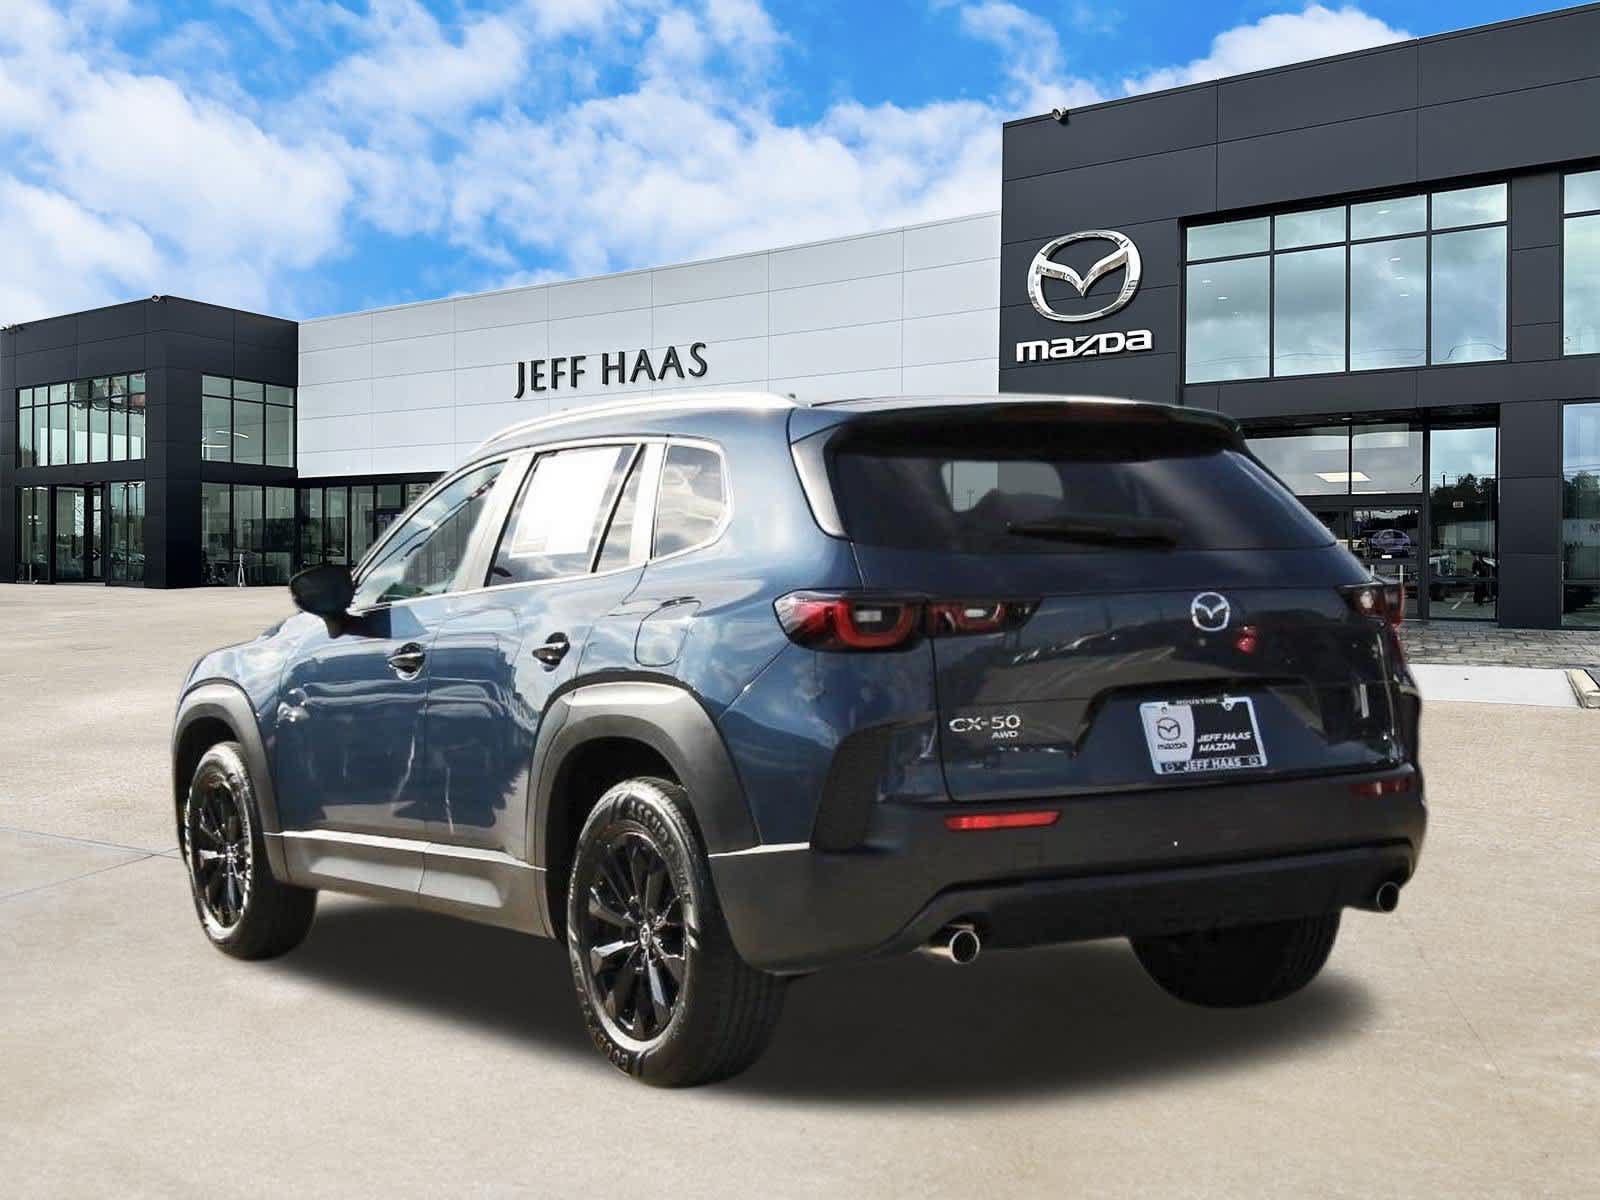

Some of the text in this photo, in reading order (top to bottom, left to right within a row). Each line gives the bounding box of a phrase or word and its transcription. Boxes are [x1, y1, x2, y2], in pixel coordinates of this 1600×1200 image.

[1015, 330, 1152, 362] mazda
[514, 342, 708, 399] JEFF HAAS
[949, 714, 1020, 732] CX-50
[991, 731, 1018, 739] AWD
[1197, 731, 1252, 743] JEFF HAAS
[1199, 742, 1236, 751] MAZDA
[1183, 756, 1242, 771] JEFF HAAS
